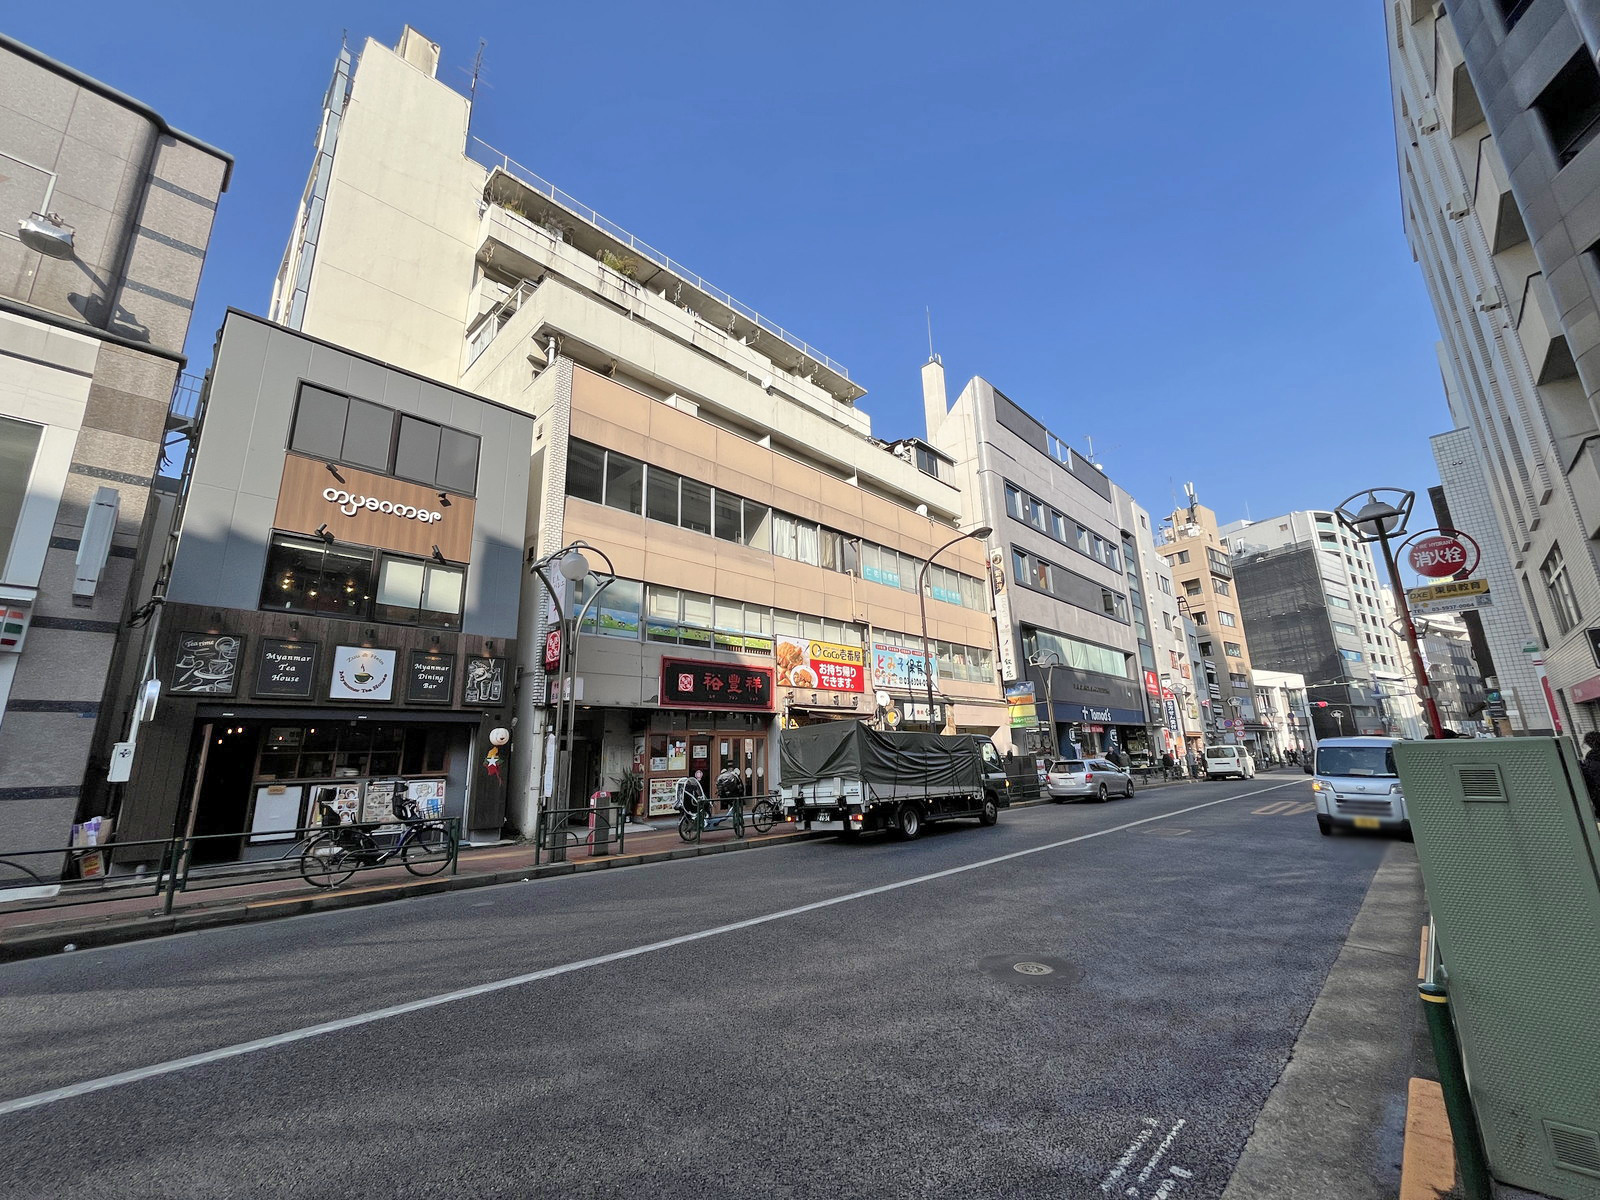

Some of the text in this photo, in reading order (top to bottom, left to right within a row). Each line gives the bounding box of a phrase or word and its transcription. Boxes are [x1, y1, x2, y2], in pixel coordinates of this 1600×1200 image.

[1428, 539, 1454, 548] HYDRANT
[1413, 546, 1464, 568] 消火栓
[1410, 591, 1428, 600] DXE
[266, 652, 312, 663] Myanmar
[823, 649, 861, 662] CoCo壱番屋
[279, 663, 296, 672] Tea
[414, 663, 450, 671] Myanmar
[819, 663, 857, 678] お持ち帰り
[271, 673, 300, 682] House
[418, 674, 444, 683] Dining
[821, 675, 855, 689] できます。
[1089, 708, 1112, 722] Tomod's
